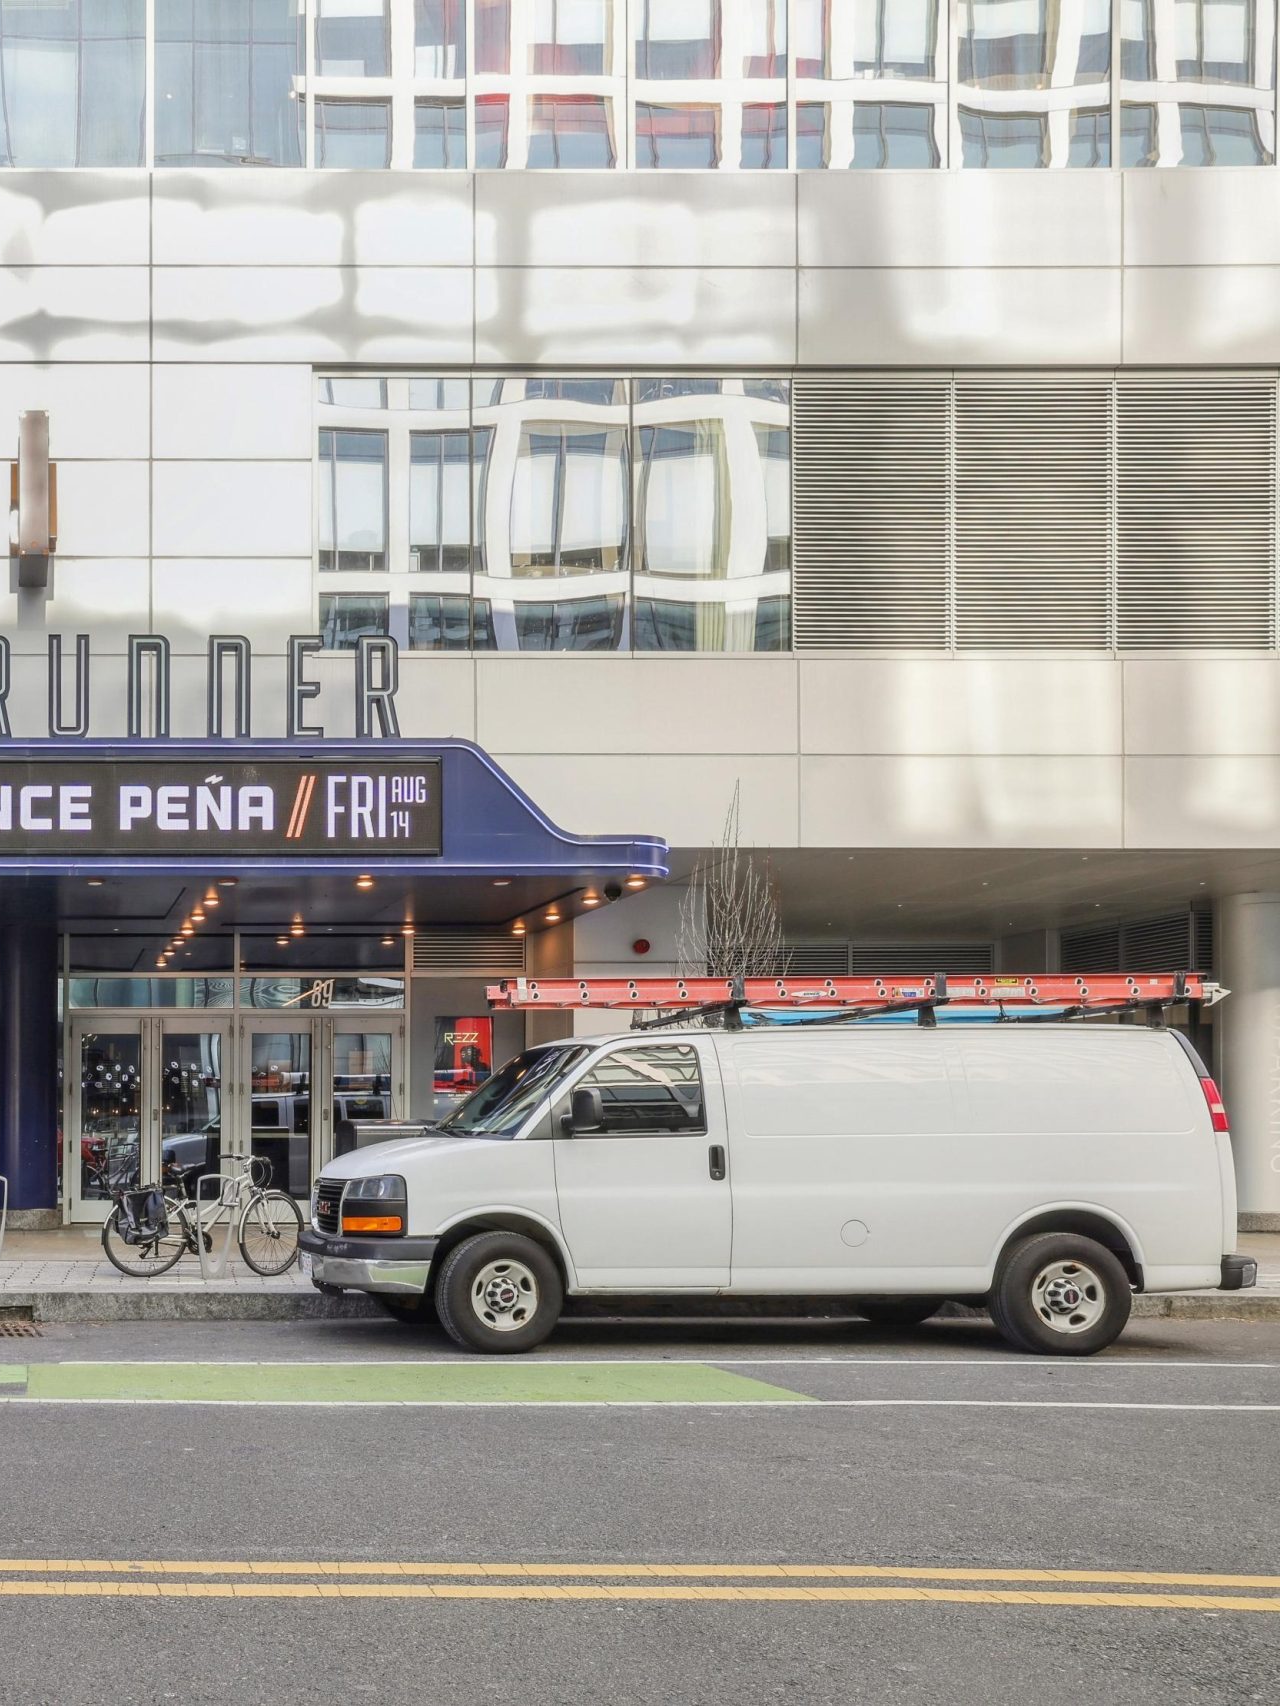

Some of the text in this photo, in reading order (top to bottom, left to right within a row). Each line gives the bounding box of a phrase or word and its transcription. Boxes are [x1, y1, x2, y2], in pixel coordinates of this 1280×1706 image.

[391, 776, 426, 803] AUG
[120, 774, 274, 831] PEÑA
[327, 775, 386, 838] FRI
[390, 811, 409, 838] 14
[311, 979, 334, 1007] 89
